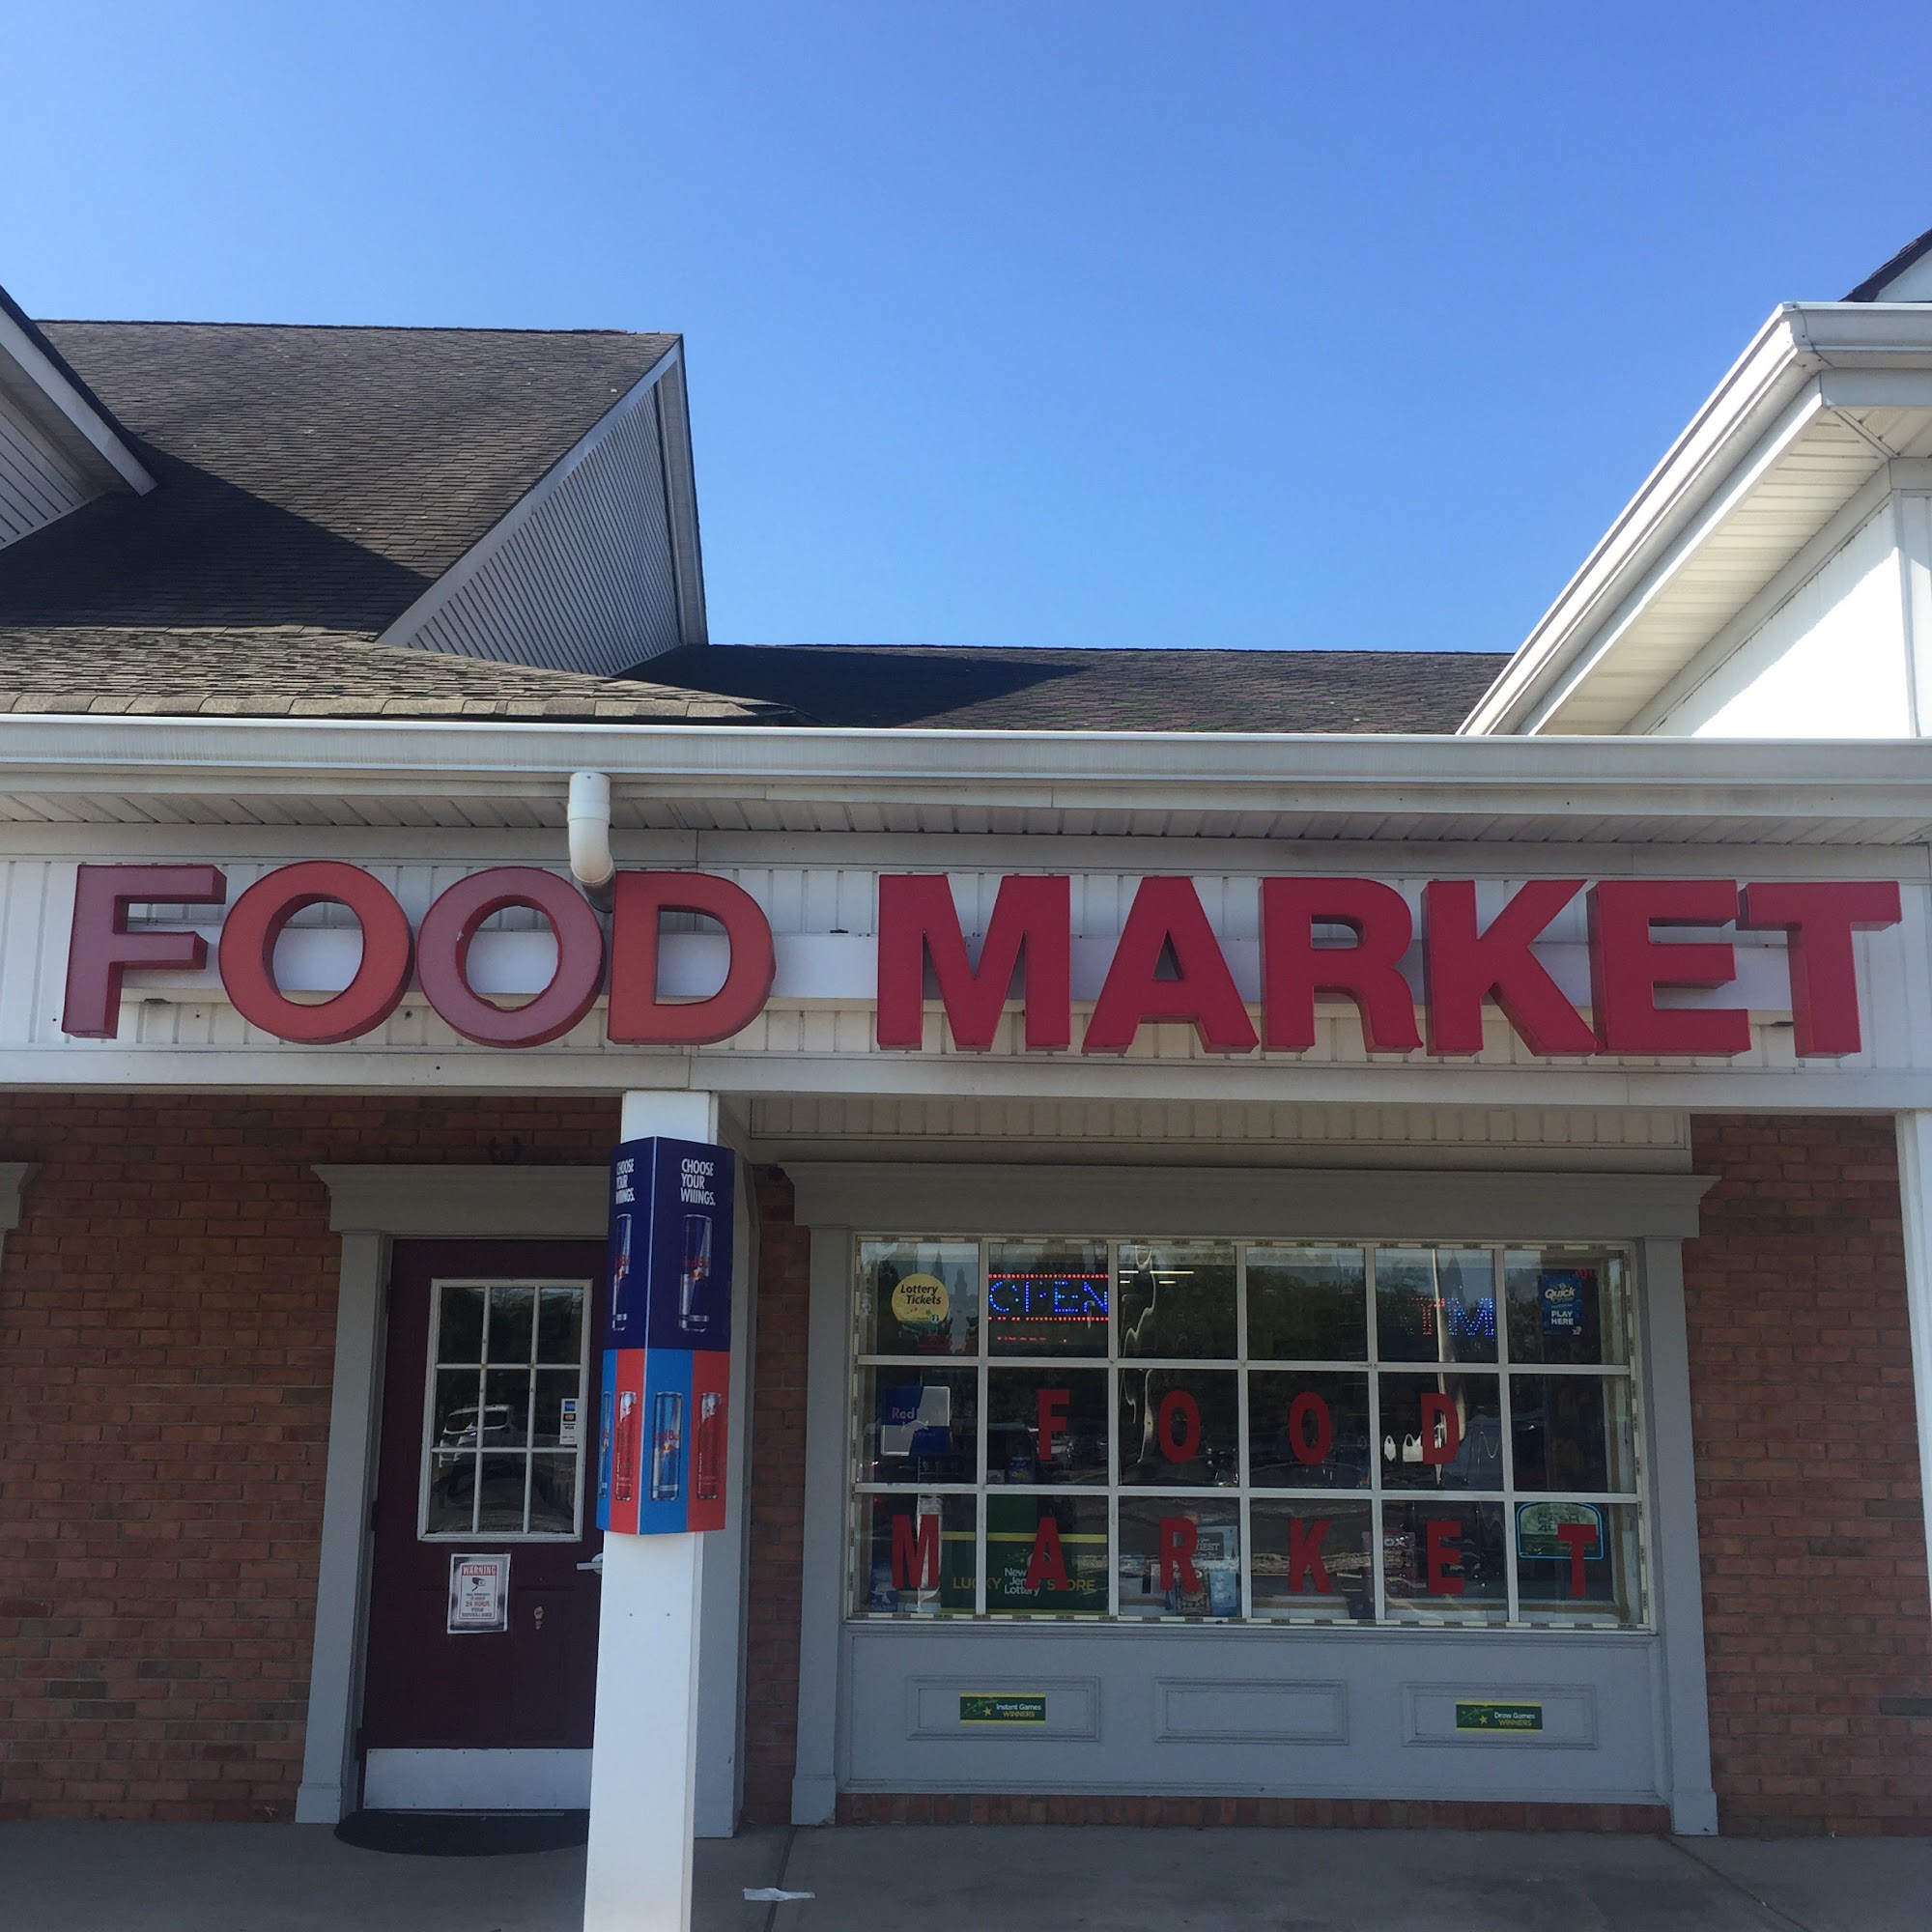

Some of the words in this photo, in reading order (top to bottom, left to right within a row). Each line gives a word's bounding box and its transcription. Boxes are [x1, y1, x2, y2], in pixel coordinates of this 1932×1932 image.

[62, 860, 777, 1049] FOOD
[876, 873, 1902, 1059] MARKET
[681, 1158, 714, 1177] CHOOSE
[680, 1173, 705, 1189] YOUR
[900, 1285, 938, 1295] Lottery
[906, 1295, 942, 1305] Tickets
[892, 1406, 915, 1419] Red
[463, 1565, 497, 1576] WARNING
[1004, 1567, 1027, 1577] New
[952, 1577, 1003, 1591] LUKY
[1046, 1578, 1096, 1592] SORE
